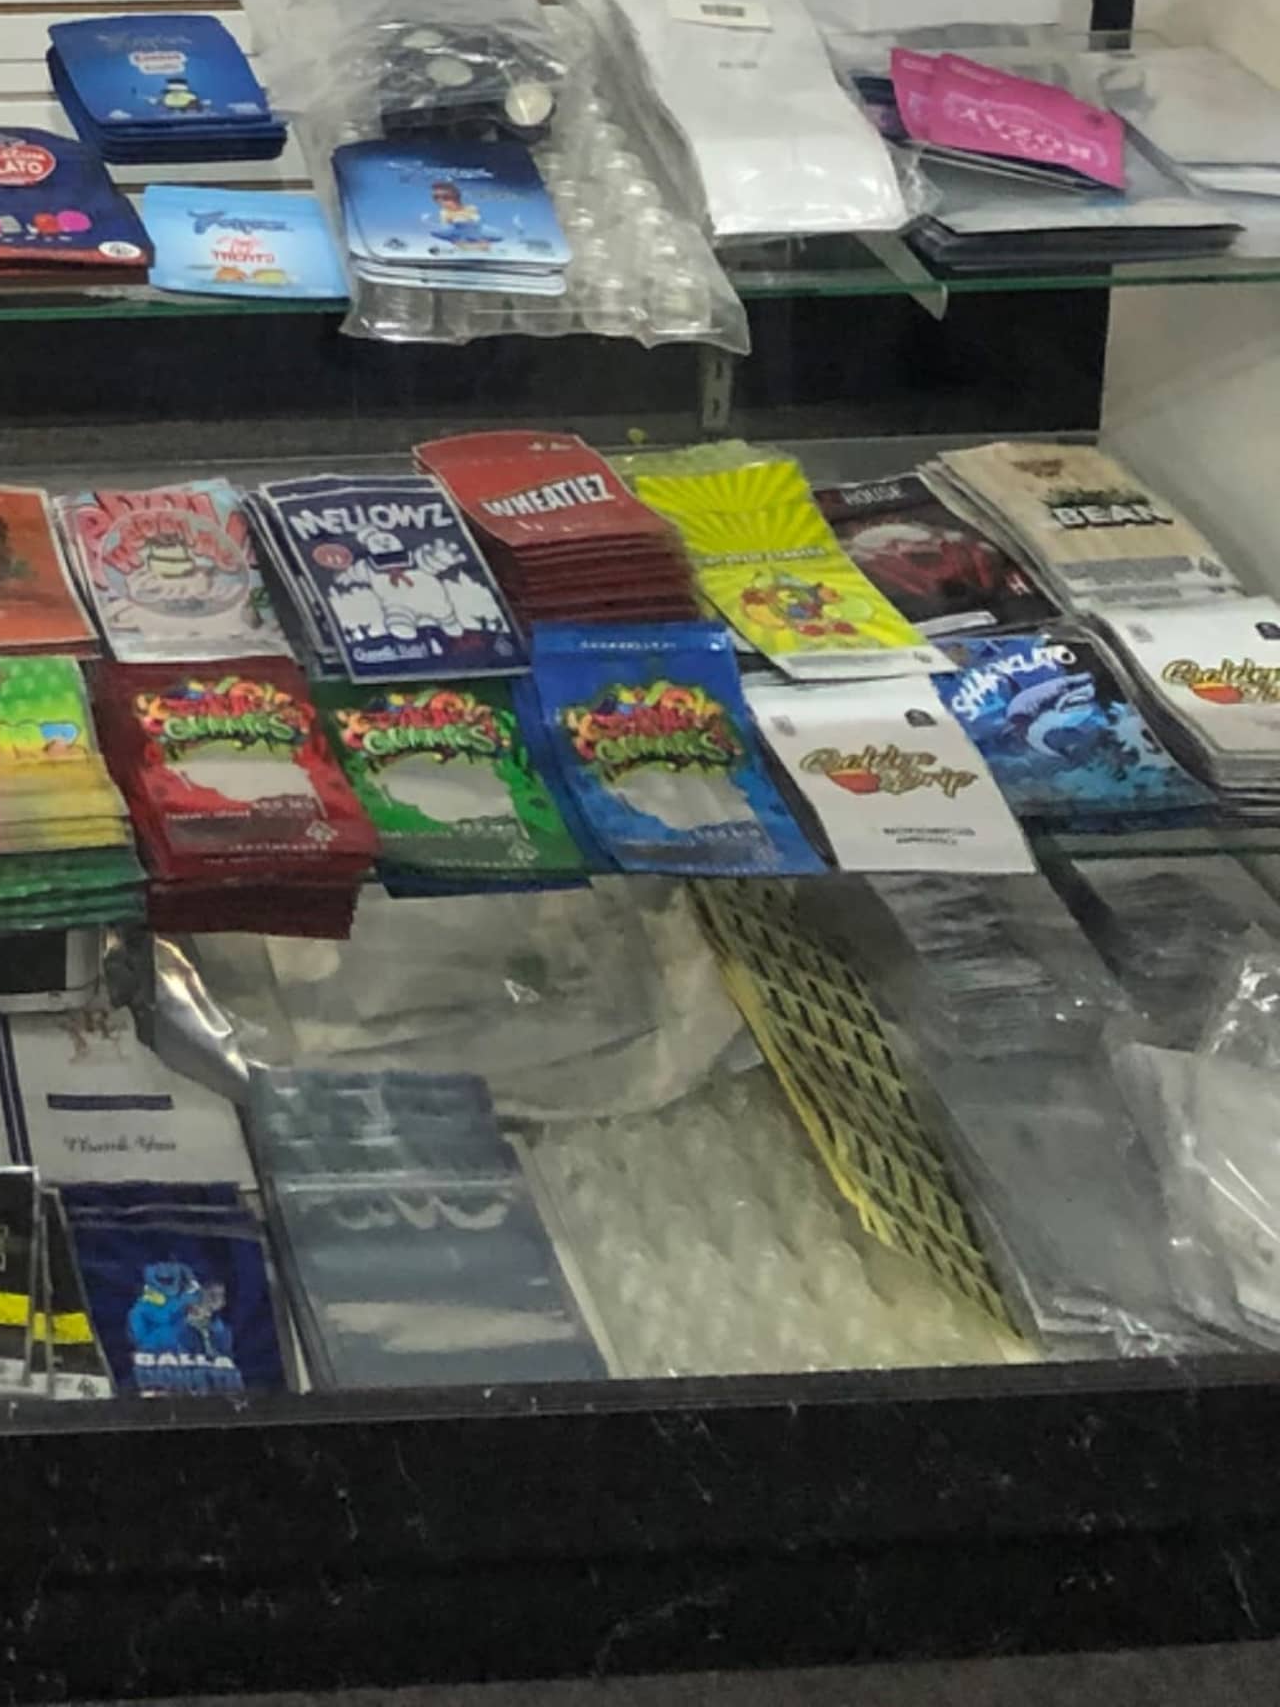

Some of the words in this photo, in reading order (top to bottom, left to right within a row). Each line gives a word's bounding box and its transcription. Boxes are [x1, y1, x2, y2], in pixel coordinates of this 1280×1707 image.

[483, 473, 616, 520] WHEATIEZ
[290, 502, 455, 540] MELLOWZ
[64, 1135, 130, 1154] Thank
[134, 1135, 178, 1153] You
[133, 1352, 236, 1369] BALLA
